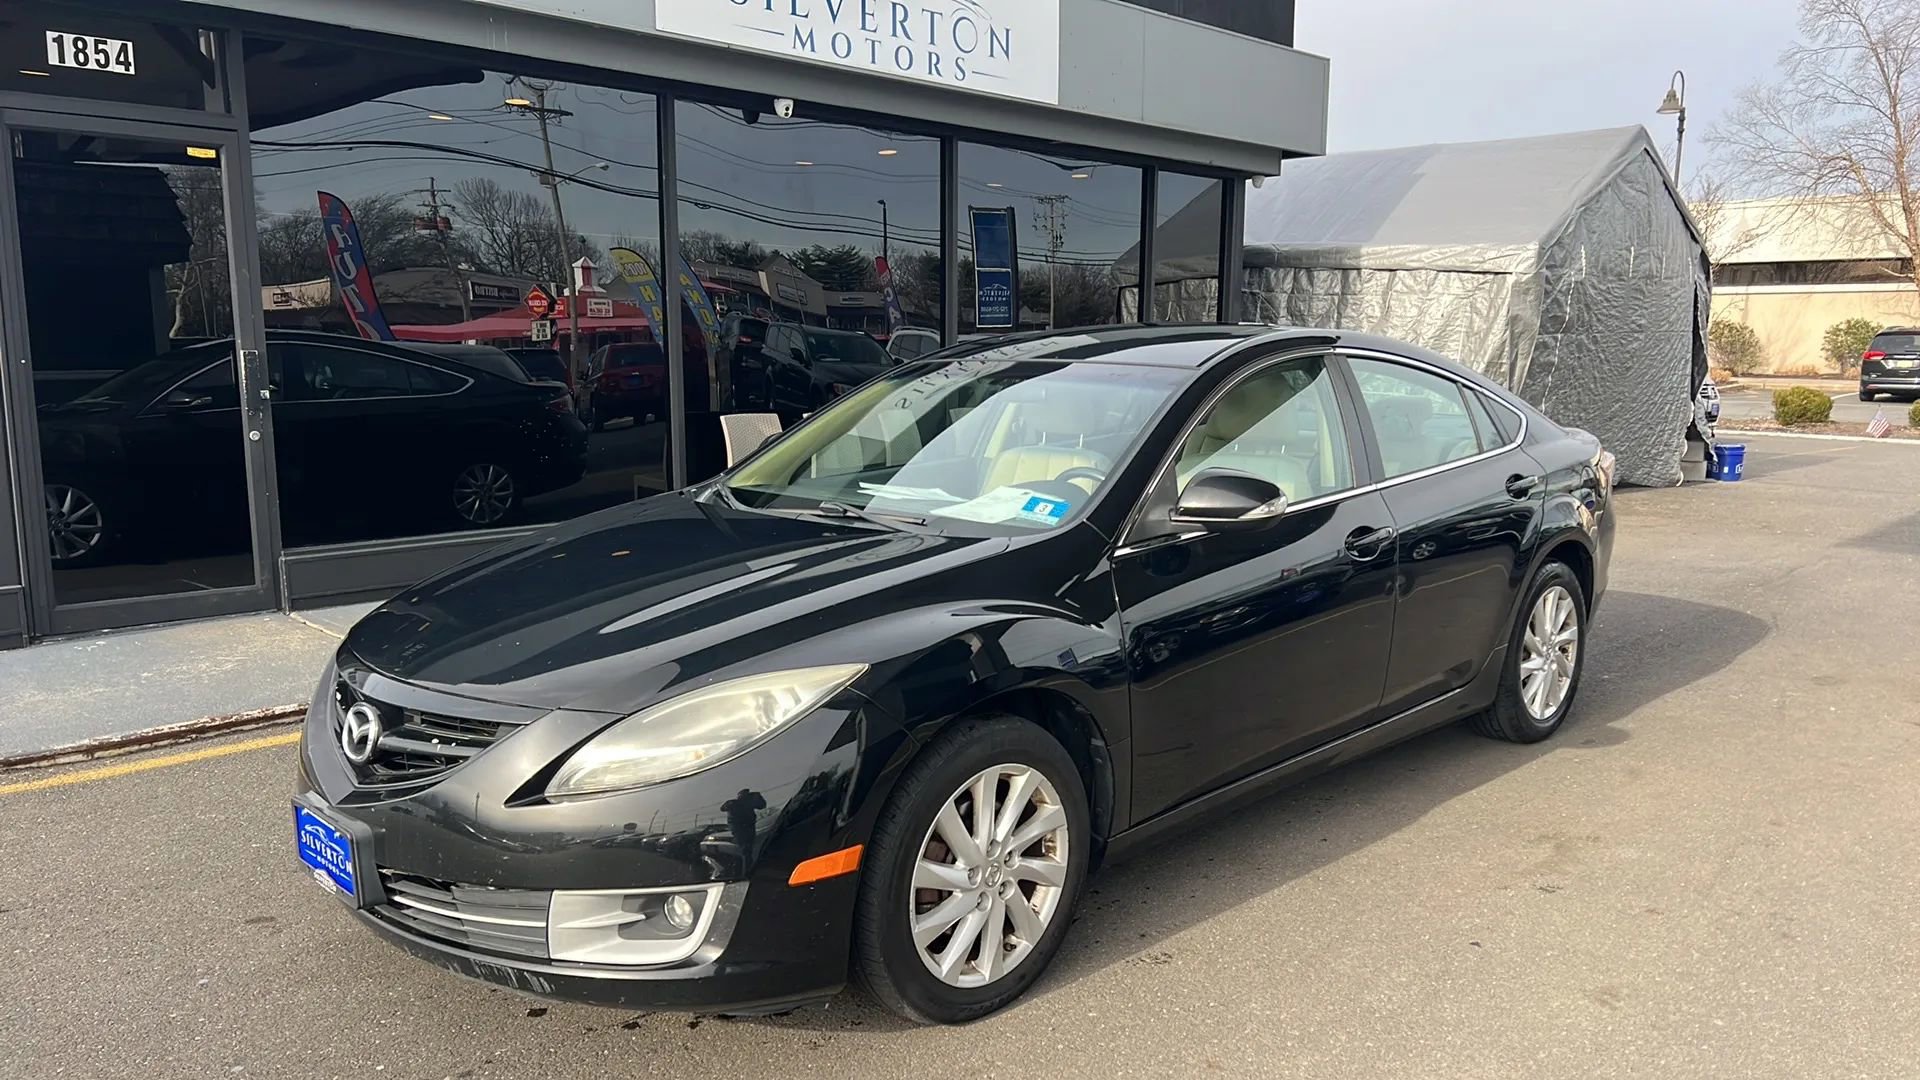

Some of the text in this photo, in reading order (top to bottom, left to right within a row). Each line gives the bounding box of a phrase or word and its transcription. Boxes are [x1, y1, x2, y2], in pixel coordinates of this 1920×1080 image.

[730, 0, 1011, 61] VERTON
[792, 24, 966, 81] MOTORS
[52, 34, 132, 72] 1854
[1039, 504, 1049, 513] 3
[301, 830, 353, 874] SILVERTON
